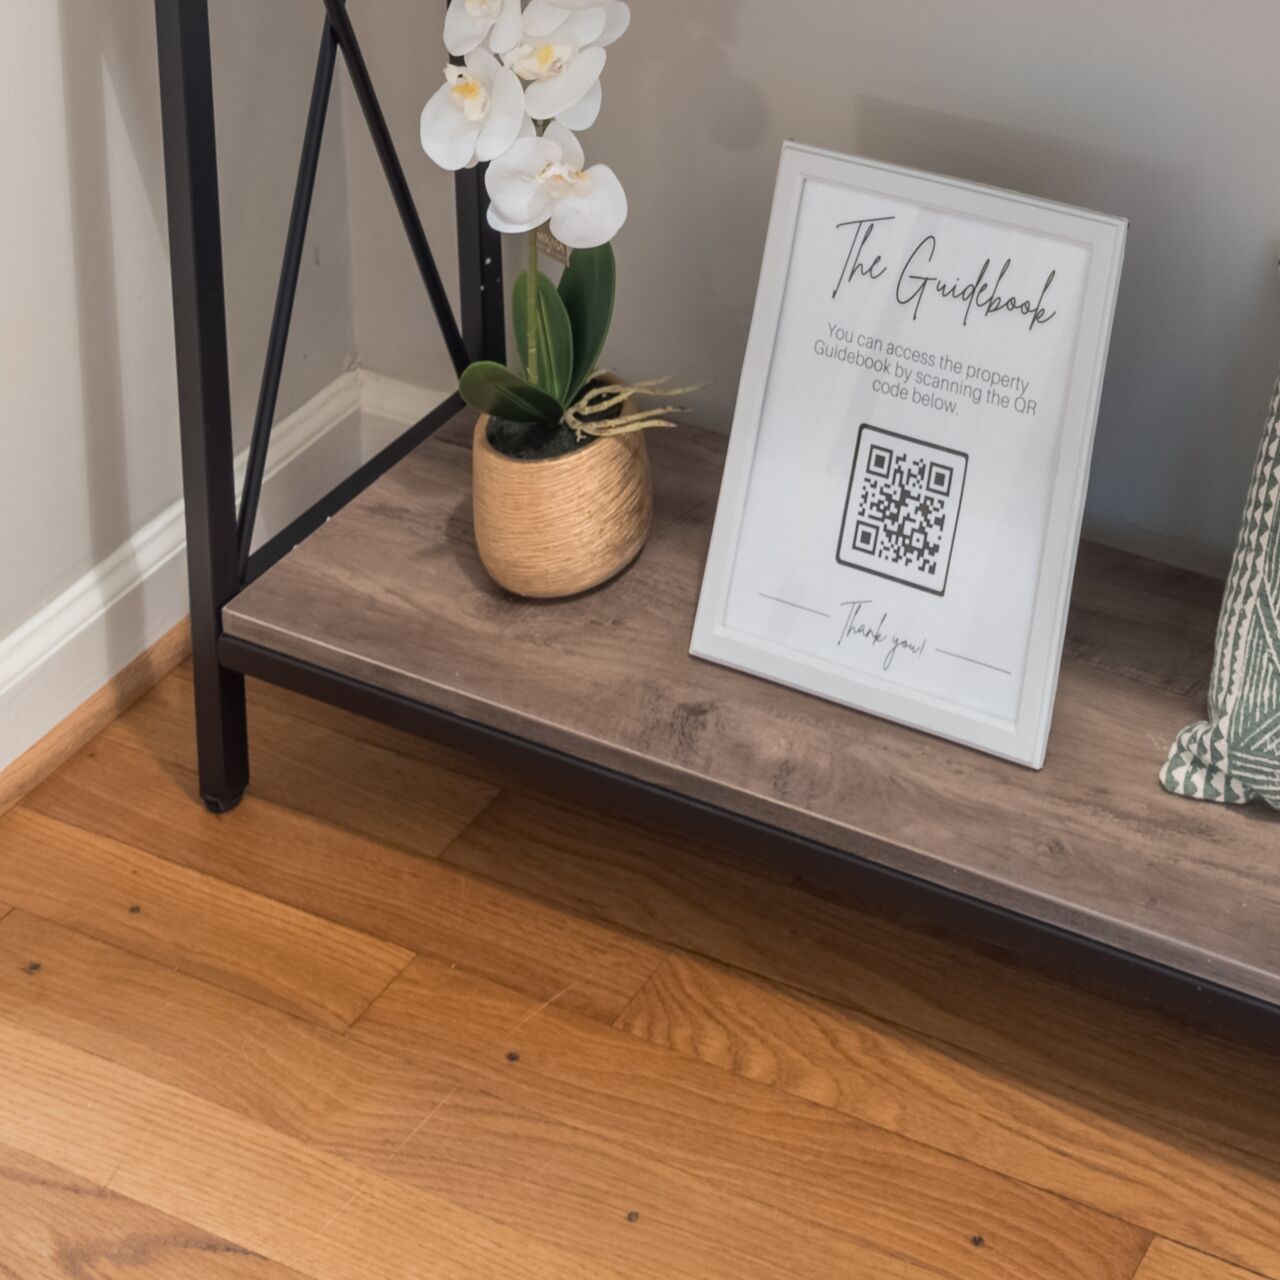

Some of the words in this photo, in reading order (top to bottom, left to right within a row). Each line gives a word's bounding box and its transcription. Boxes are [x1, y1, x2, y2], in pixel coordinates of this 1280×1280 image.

[832, 216, 896, 299] The
[895, 235, 1057, 331] Guidebook
[813, 339, 892, 375] Guidebook
[894, 364, 913, 384] by
[915, 370, 983, 405] scanning
[986, 389, 1010, 408] the
[1014, 395, 1038, 417] QR
[827, 322, 853, 343] You
[857, 334, 883, 352] can
[886, 341, 936, 368] access
[939, 354, 963, 374] the
[965, 364, 1030, 396] property
[872, 378, 909, 401] code
[912, 387, 959, 416] below.
[837, 600, 888, 646] Thank
[883, 635, 928, 672] you!
